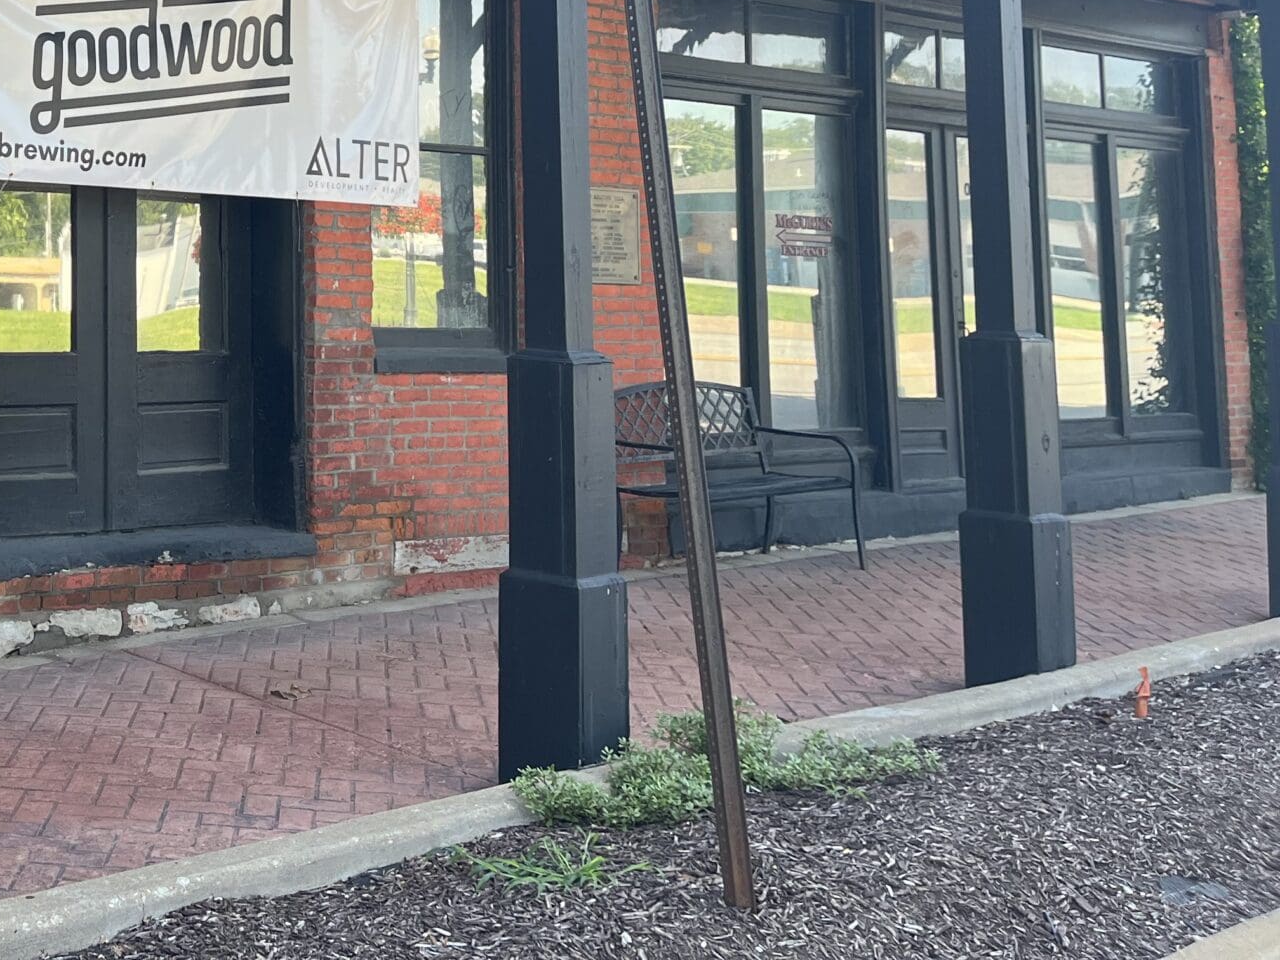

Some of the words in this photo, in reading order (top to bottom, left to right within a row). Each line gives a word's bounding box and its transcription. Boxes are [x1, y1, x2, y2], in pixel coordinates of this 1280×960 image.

[305, 135, 410, 183] ALTER
[308, 180, 369, 192] DEVELOPMENT
[781, 245, 829, 256] ENTRANCE
